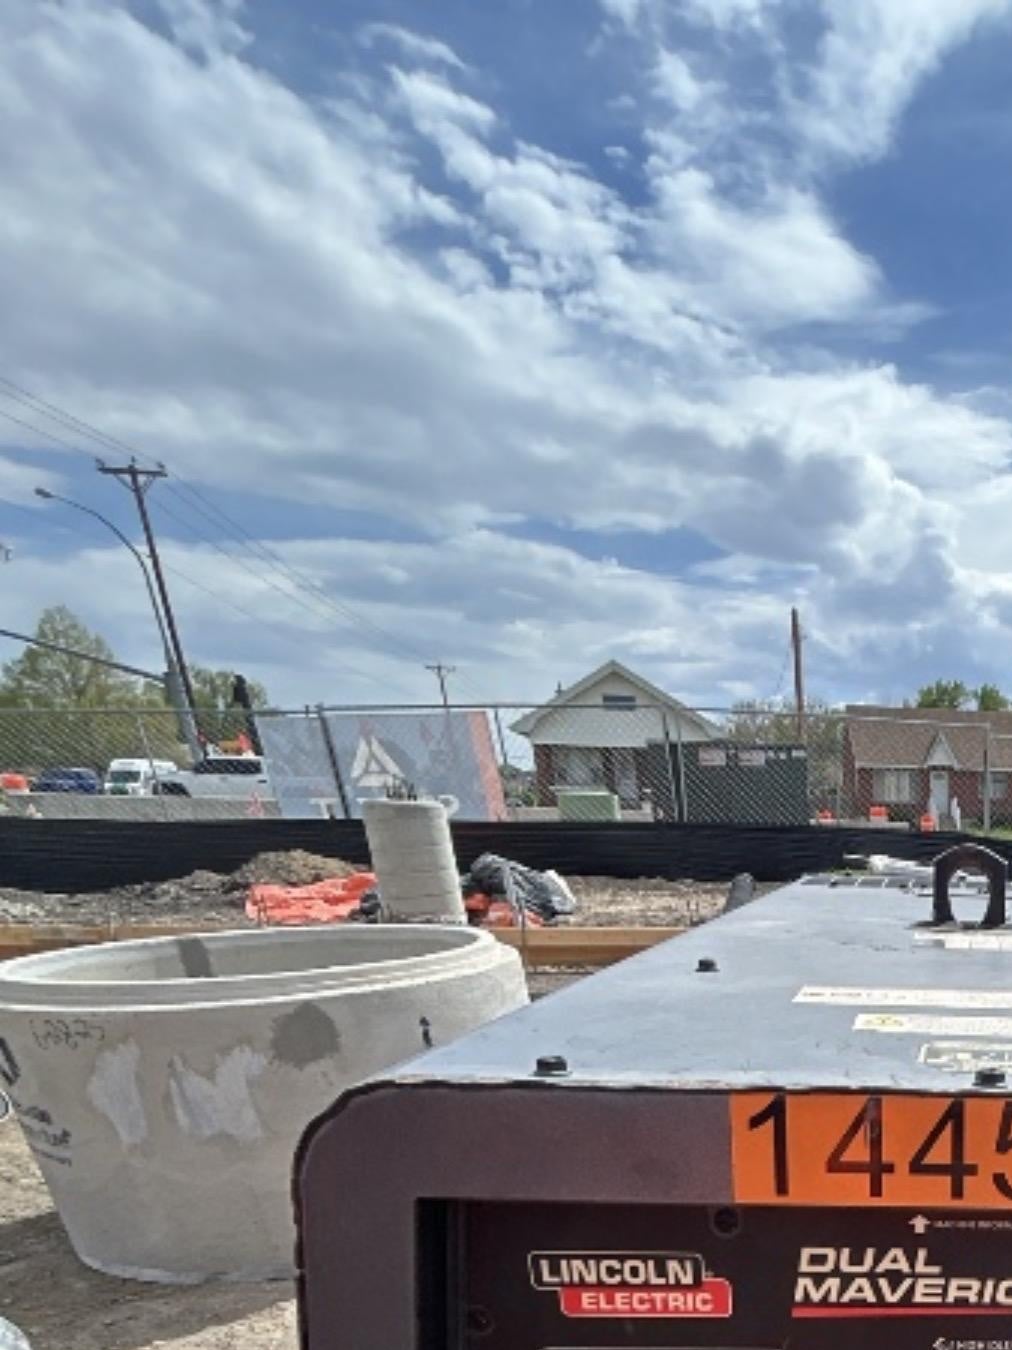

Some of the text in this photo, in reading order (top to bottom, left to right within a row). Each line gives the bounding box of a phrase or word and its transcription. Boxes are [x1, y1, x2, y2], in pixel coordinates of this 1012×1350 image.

[540, 1259, 695, 1286] LINCOLN
[799, 1247, 942, 1275] DUAL
[581, 1292, 714, 1312] ELECTRIC
